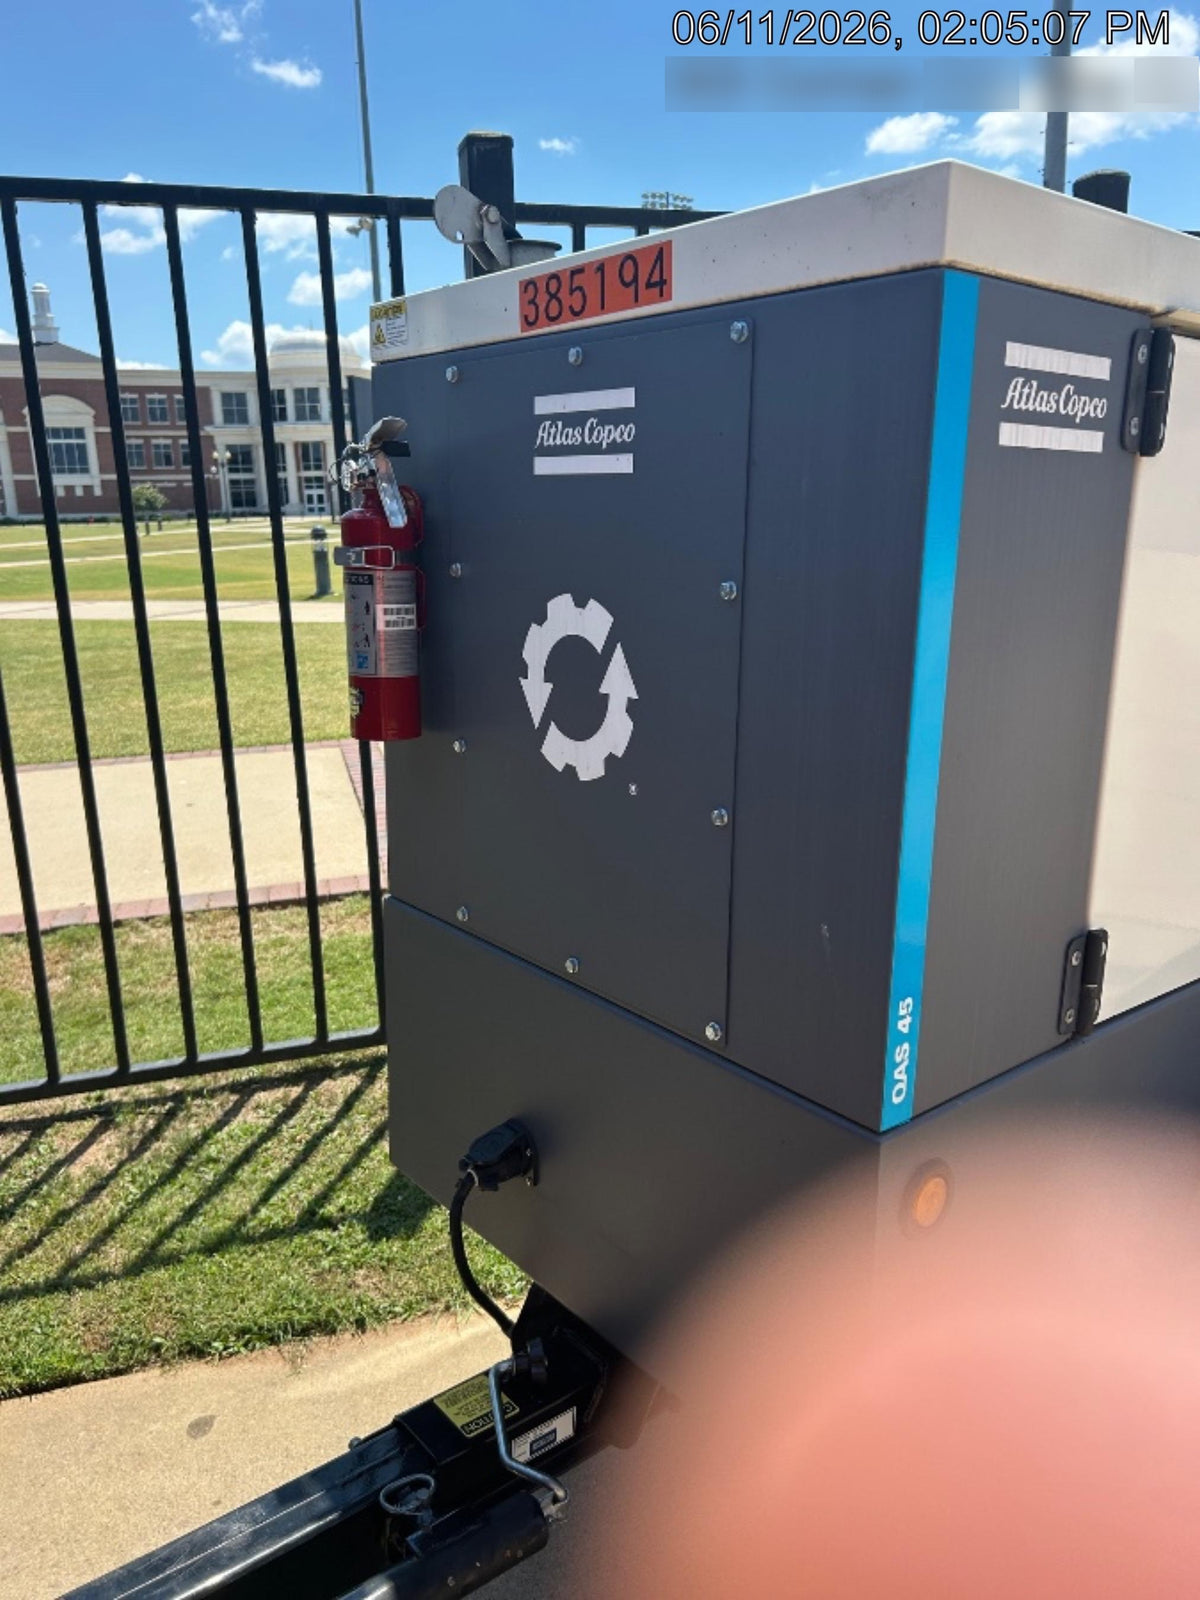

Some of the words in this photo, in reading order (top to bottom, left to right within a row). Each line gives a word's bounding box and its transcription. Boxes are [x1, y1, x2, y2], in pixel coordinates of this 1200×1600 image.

[523, 246, 668, 327] 385194
[1001, 376, 1058, 414] Atlas
[1059, 383, 1107, 424] Copco
[535, 420, 582, 449] Atlas
[584, 417, 635, 449] Copco
[897, 996, 914, 1034] 45
[892, 1042, 910, 1105] OAS
[464, 1401, 515, 1436] CUTION
